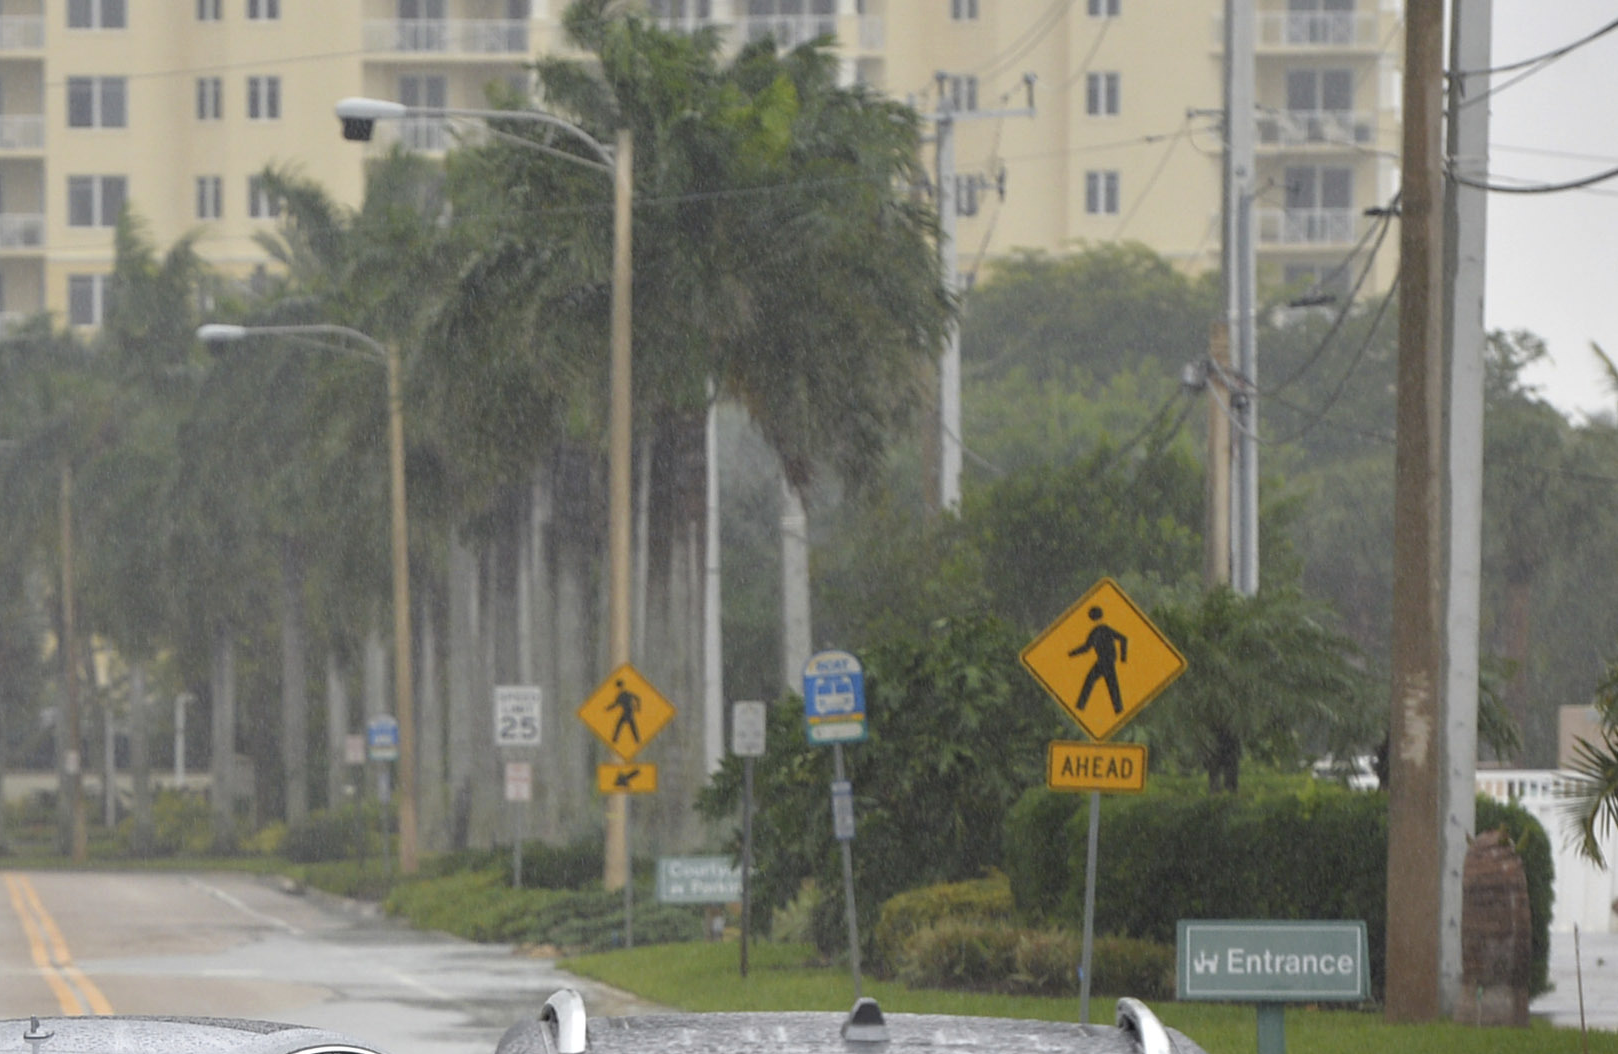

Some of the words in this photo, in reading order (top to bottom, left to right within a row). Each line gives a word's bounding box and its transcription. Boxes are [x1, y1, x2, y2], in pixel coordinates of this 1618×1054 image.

[501, 715, 538, 738] 25
[1061, 755, 1134, 779] AHEAD
[1227, 948, 1354, 975] Entrance
